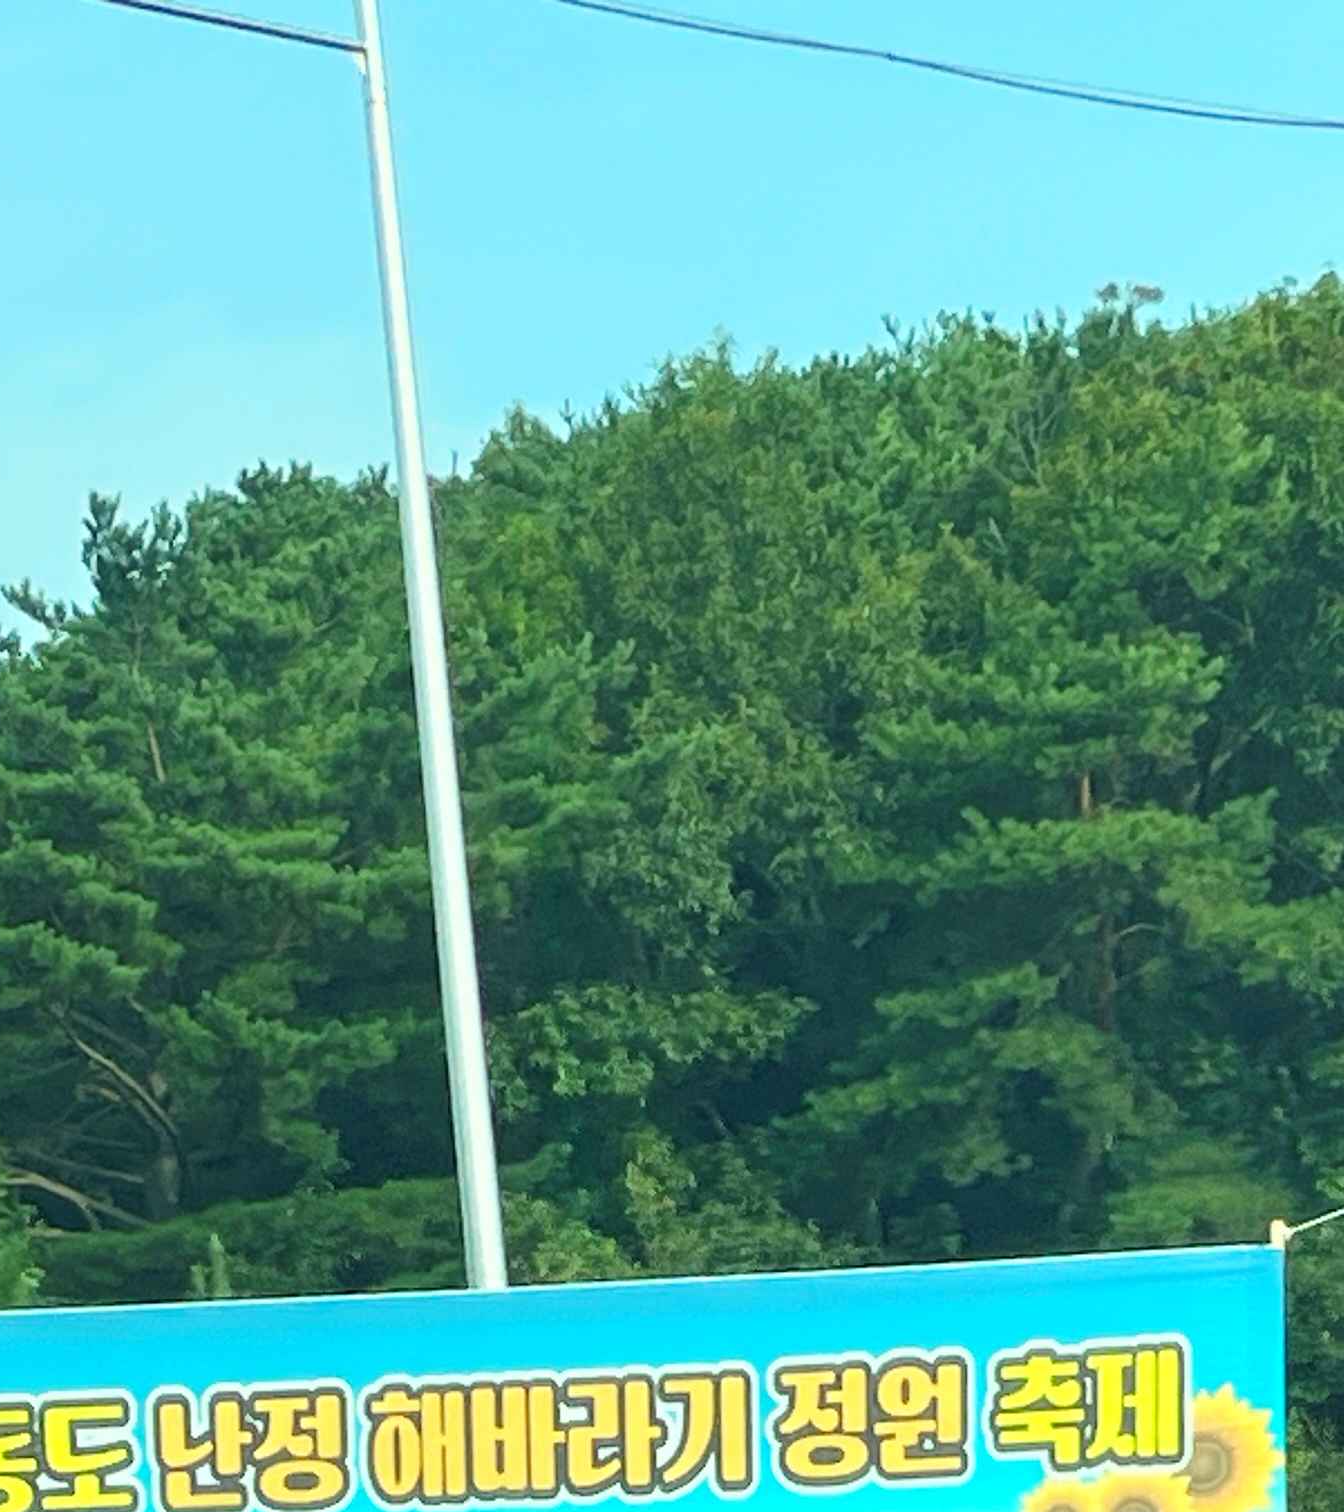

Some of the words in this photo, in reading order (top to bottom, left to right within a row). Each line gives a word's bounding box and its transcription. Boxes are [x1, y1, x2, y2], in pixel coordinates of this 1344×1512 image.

[367, 1368, 754, 1505] 해바라기
[775, 1356, 970, 1484] 정원
[990, 1341, 1185, 1468] 축제
